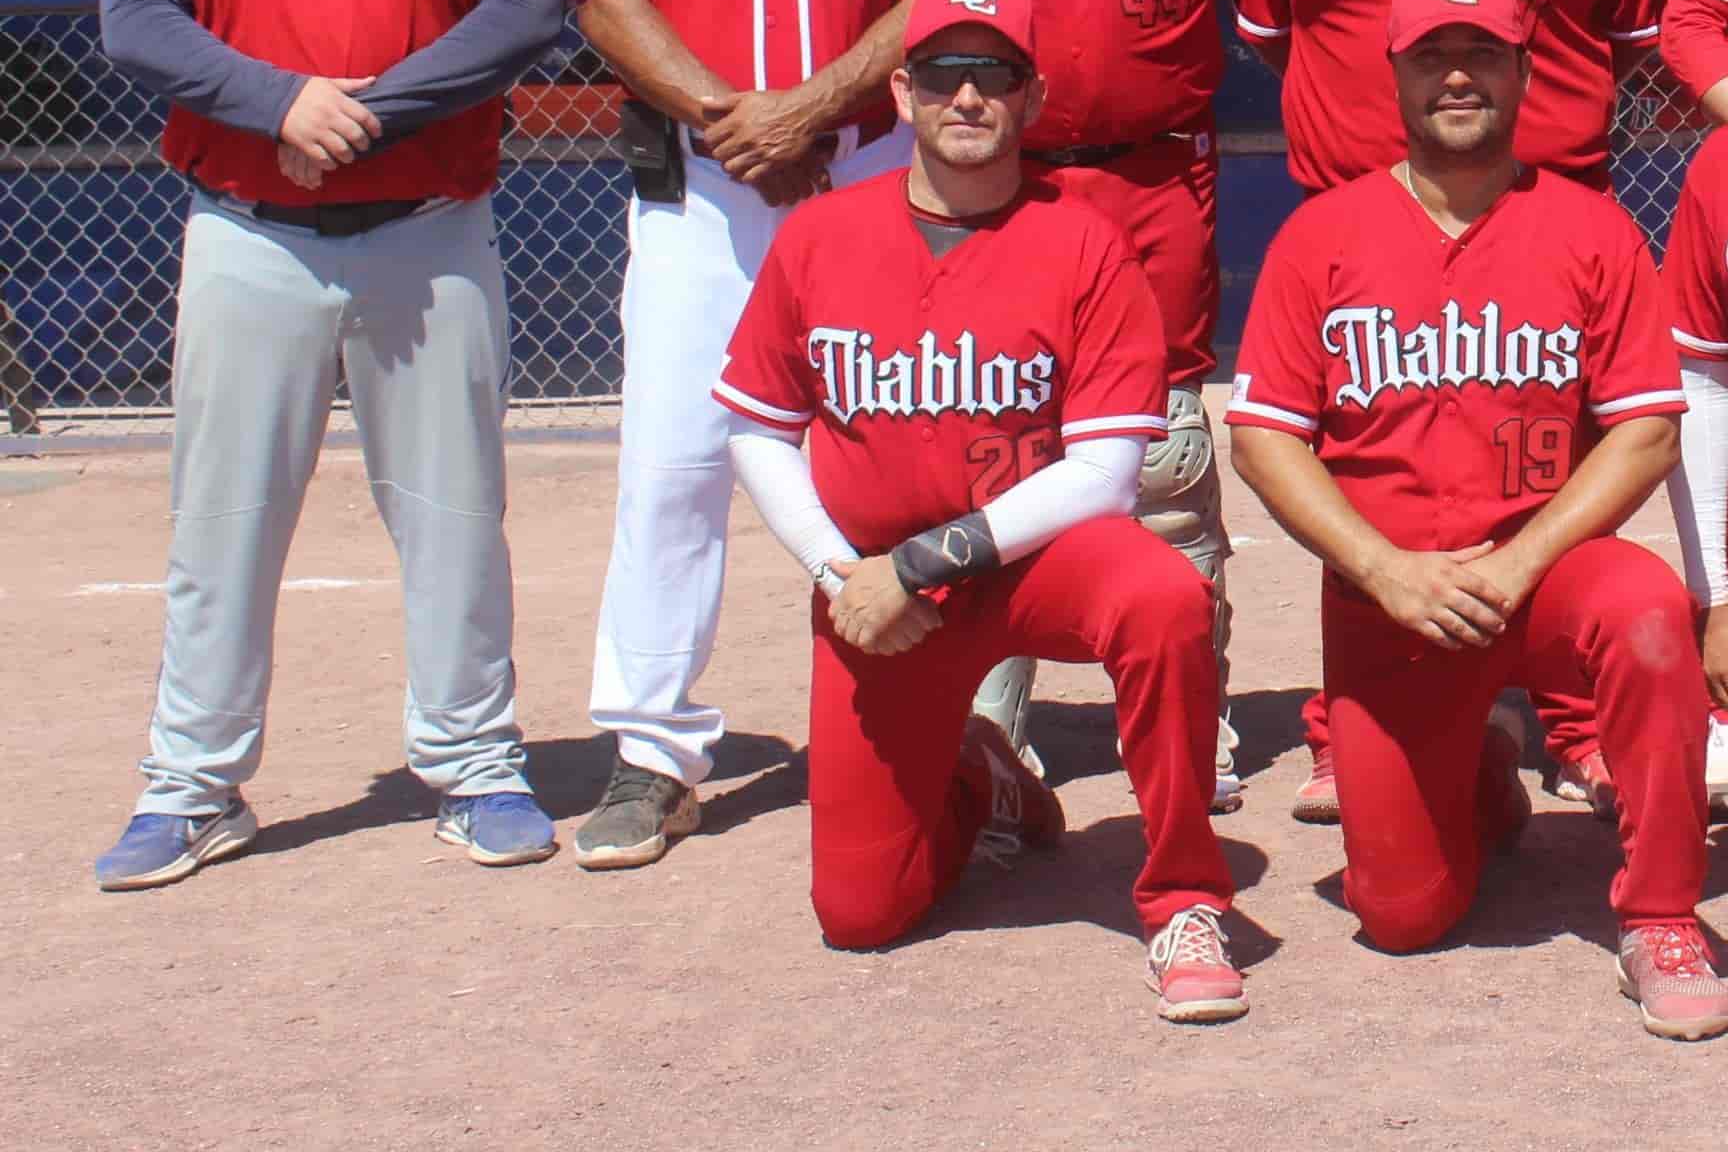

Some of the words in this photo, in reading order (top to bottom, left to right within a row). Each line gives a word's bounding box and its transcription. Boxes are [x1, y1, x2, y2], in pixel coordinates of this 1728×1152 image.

[808, 327, 1055, 425] Diablos
[1322, 298, 1582, 410] Diablos
[1494, 415, 1575, 499] 19
